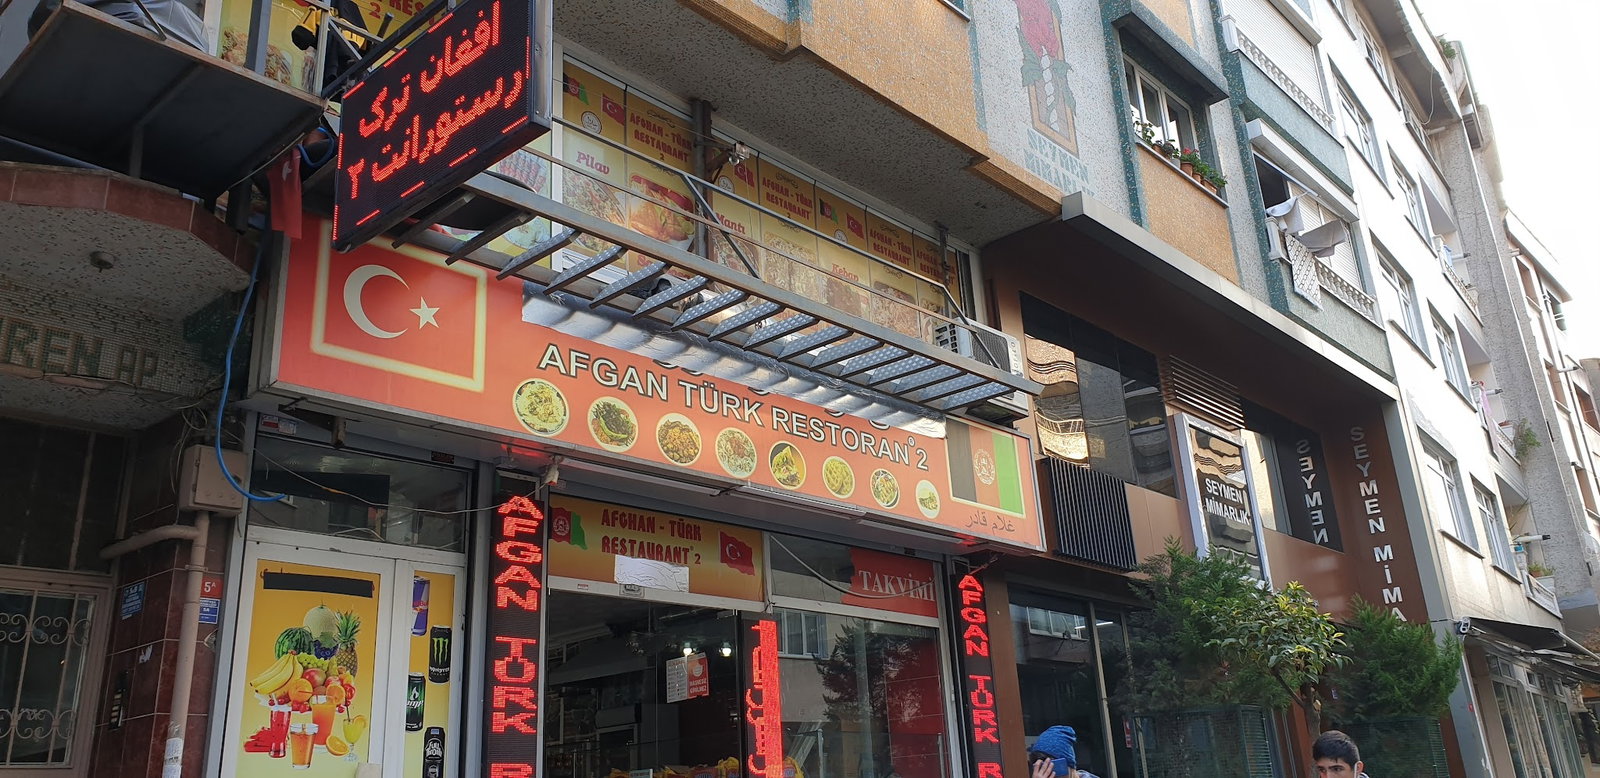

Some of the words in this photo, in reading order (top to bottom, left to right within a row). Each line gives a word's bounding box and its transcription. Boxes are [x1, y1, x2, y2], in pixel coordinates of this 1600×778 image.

[420, 0, 500, 93] افغان
[372, 70, 523, 182] رستورانت
[633, 128, 690, 163] RESTAURANT
[576, 151, 611, 176] Pilav
[0, 318, 103, 379] REN
[537, 343, 669, 402] AFGAN
[678, 379, 766, 428] TÜRK
[915, 448, 929, 471] 2
[1205, 478, 1243, 504] SEYMEN
[1352, 426, 1386, 534] SEYMEN
[601, 509, 656, 534] AFGHAN
[668, 518, 702, 542] TÜRK
[1205, 496, 1250, 525] MİMARLIK
[494, 495, 544, 612] AFGAN
[694, 553, 702, 565] 2
[858, 569, 936, 602] TAKVİMİ
[958, 575, 989, 658] AFGAN
